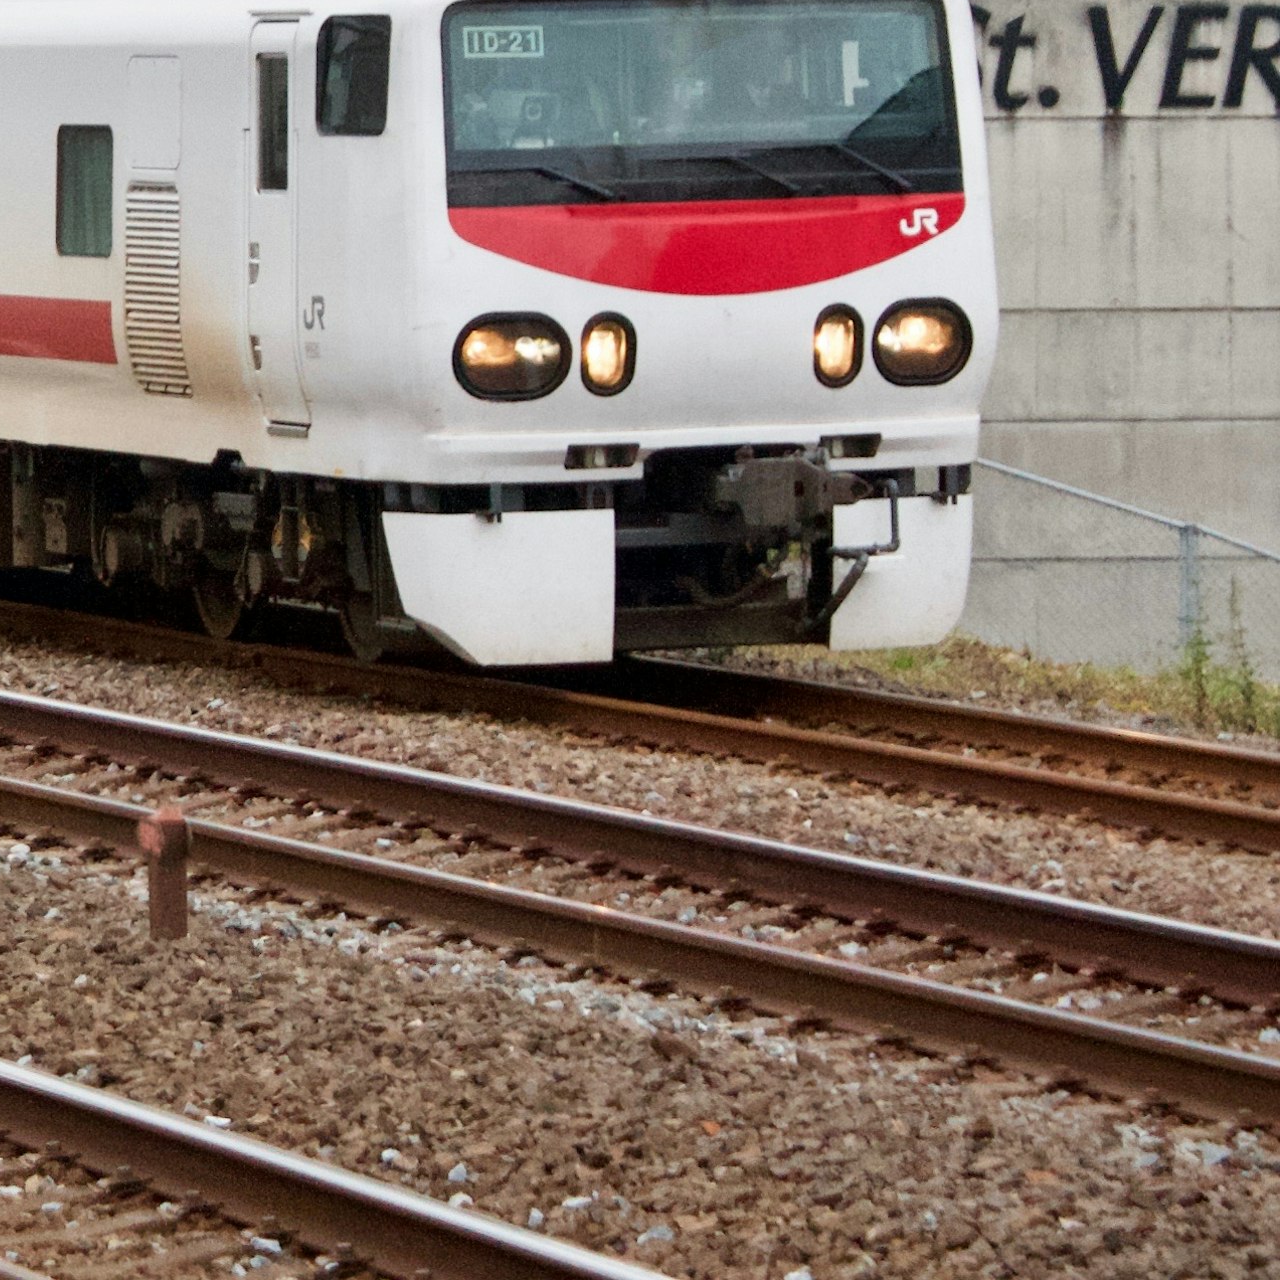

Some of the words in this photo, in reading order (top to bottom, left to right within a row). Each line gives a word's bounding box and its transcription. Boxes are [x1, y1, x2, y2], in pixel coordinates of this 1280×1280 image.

[971, 3, 1060, 110] t.
[1087, 4, 1280, 109] VER
[900, 208, 939, 236] JR
[303, 295, 325, 330] JR
